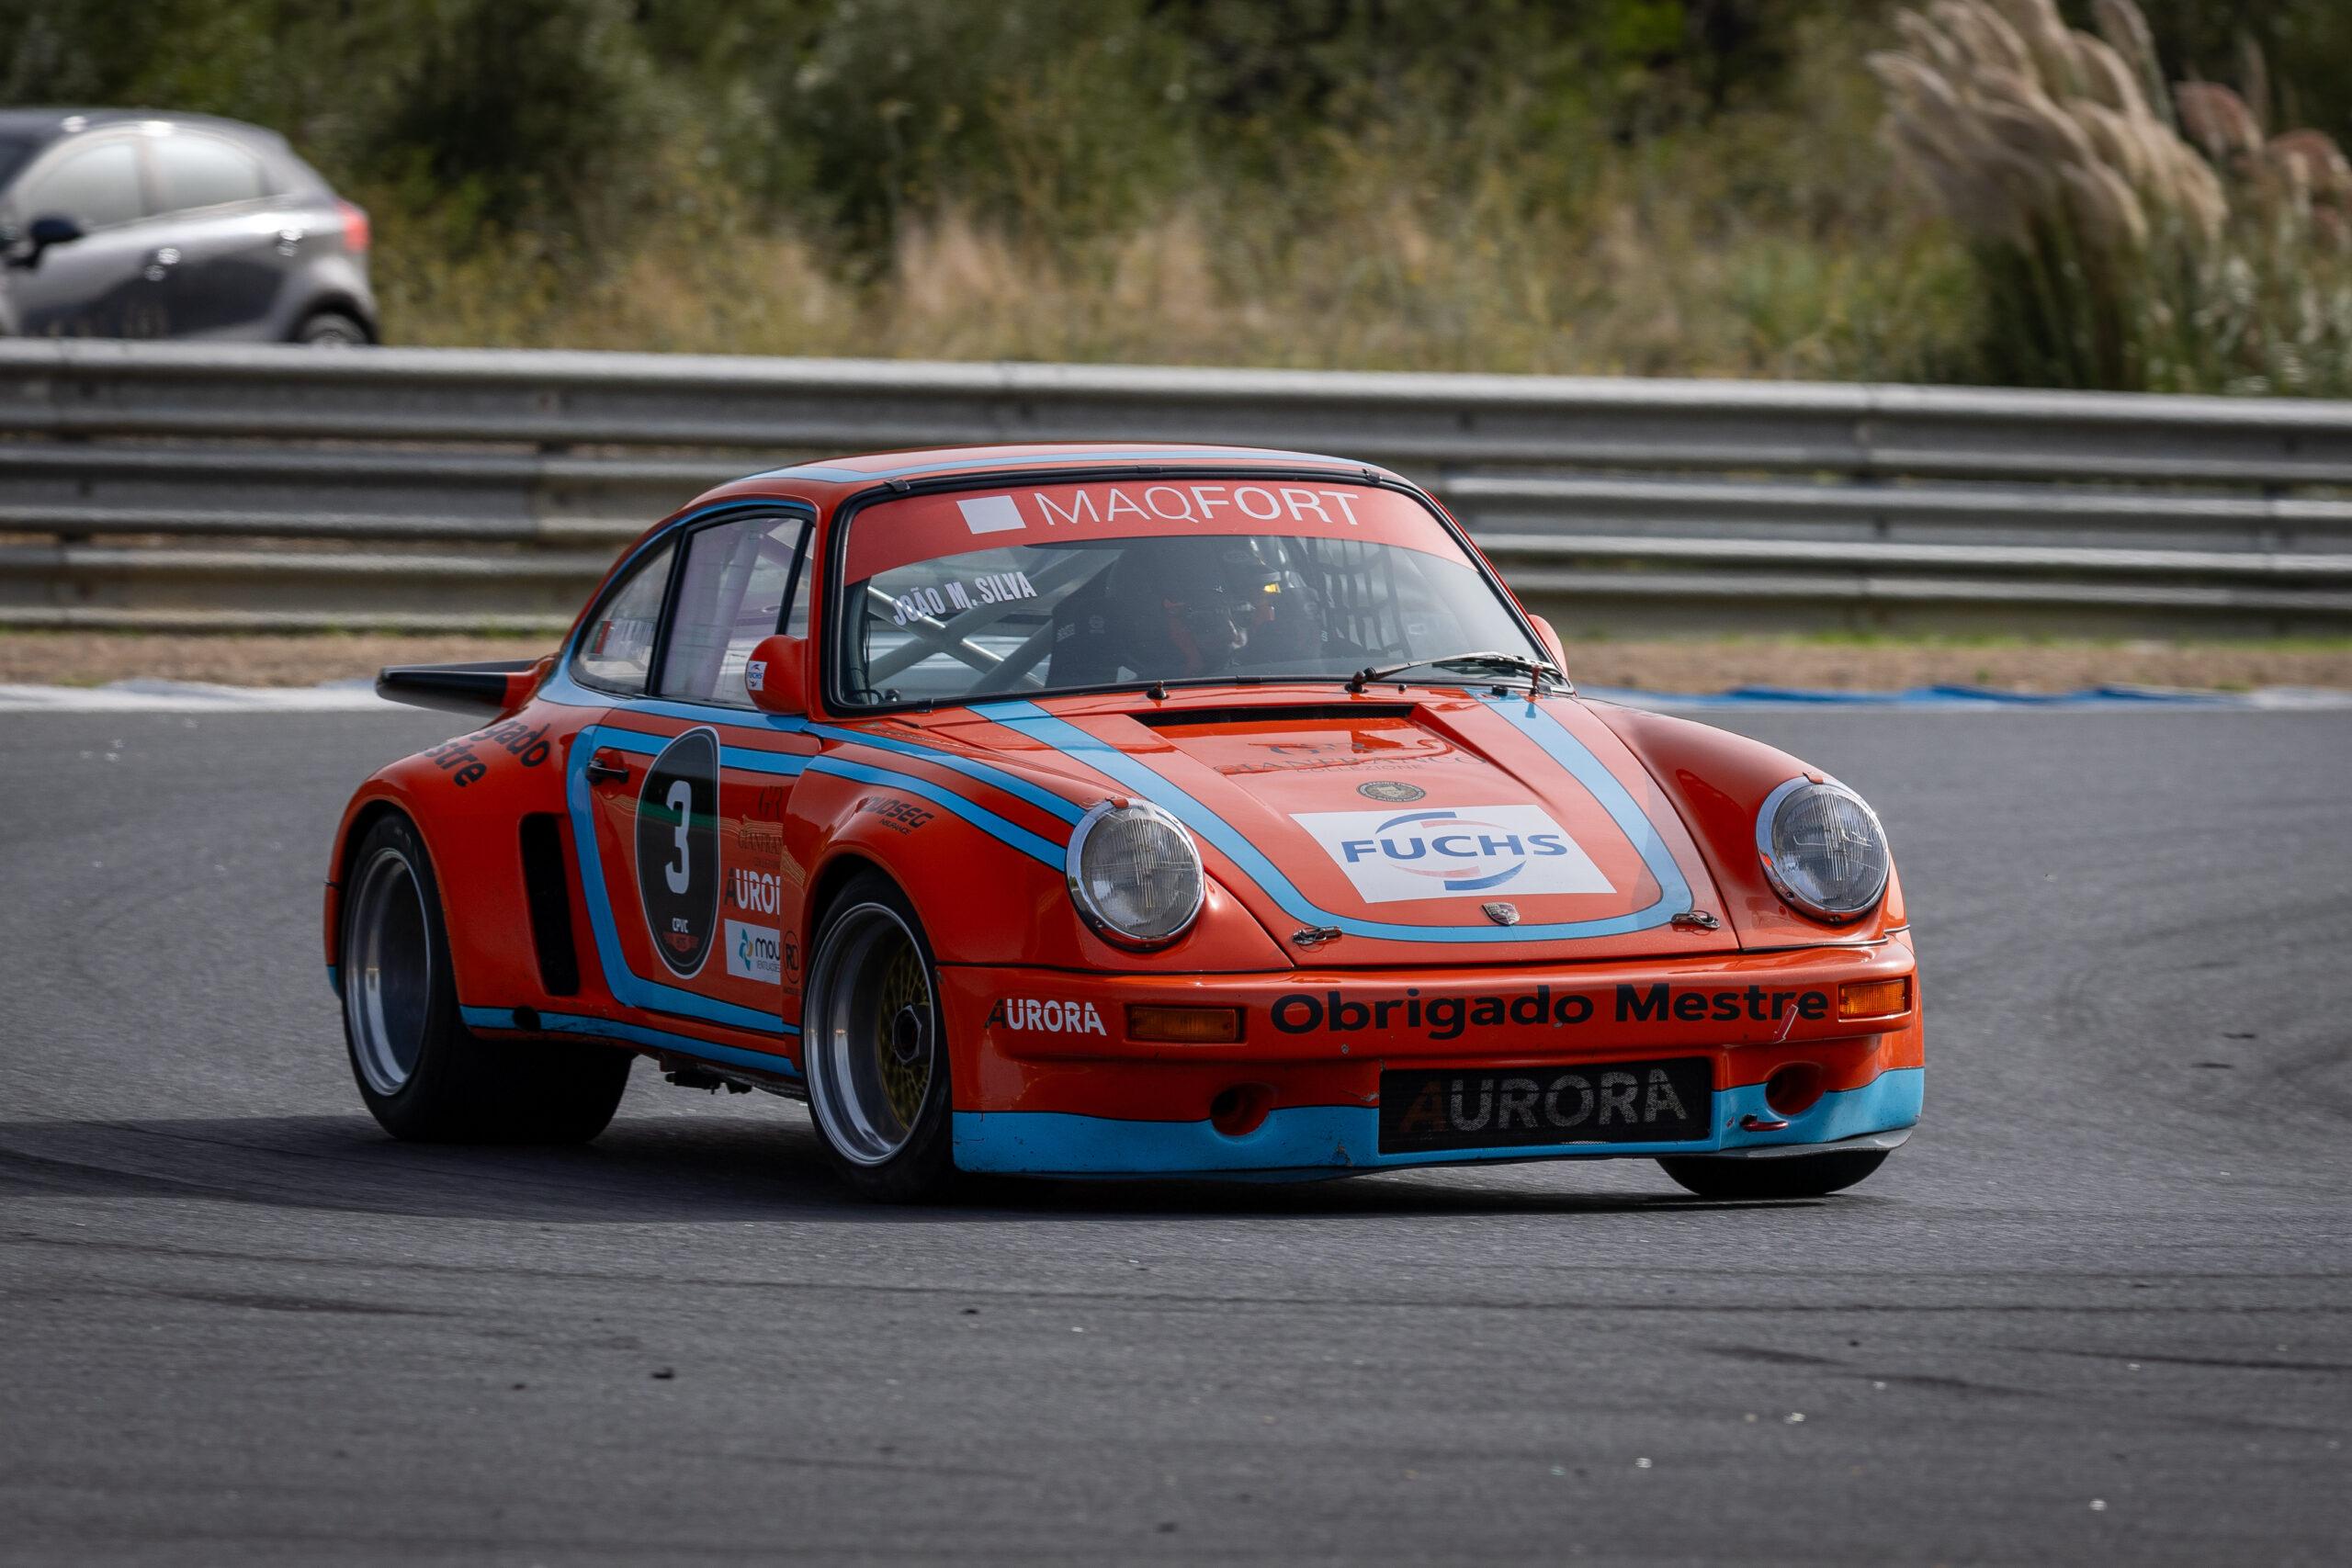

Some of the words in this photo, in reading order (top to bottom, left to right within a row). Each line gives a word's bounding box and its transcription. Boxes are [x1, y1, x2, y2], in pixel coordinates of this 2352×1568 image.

[1034, 485, 1360, 526] MAQFORT
[892, 586, 946, 626] JOÃO
[944, 581, 978, 610] M.
[974, 571, 1037, 604] SILVA
[1213, 756, 1487, 774] GIANFRANCO
[1296, 763, 1421, 774] COLLEZIONE
[665, 780, 692, 895] 3
[1340, 834, 1568, 863] FUCHS
[983, 998, 1107, 1036] AURORA
[1270, 985, 1594, 1040] Obrigado
[1615, 983, 1829, 1022] Mestre
[1398, 1068, 1689, 1132] AURORA
